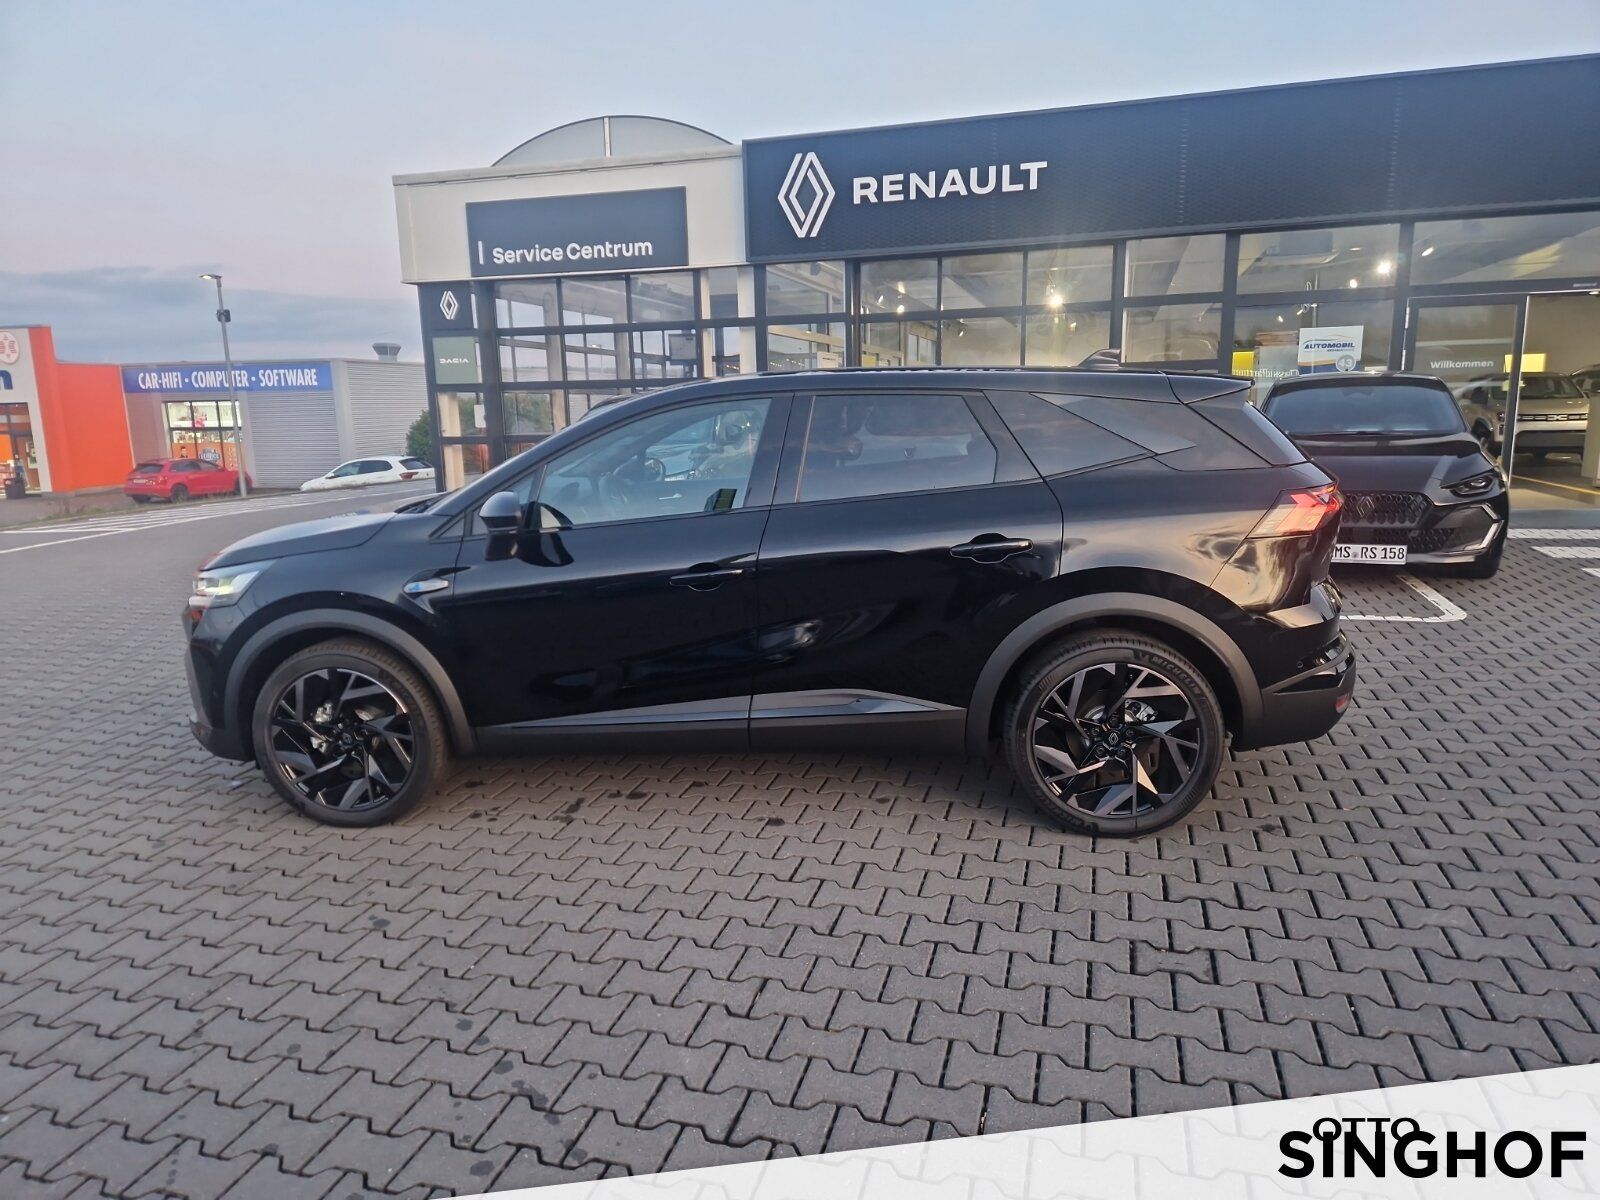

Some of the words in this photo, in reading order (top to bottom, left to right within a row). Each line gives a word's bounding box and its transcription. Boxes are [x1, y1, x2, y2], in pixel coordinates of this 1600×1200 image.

[852, 161, 1048, 205] RENAULT
[492, 244, 564, 264] Service
[566, 241, 653, 262] Centrum
[1304, 342, 1356, 350] AUTOMOBIL
[1430, 359, 1495, 370] Willkommen
[191, 370, 249, 388] COMPUTER
[259, 368, 318, 387] SOFTWARE
[1333, 546, 1351, 559] MS
[1360, 546, 1378, 560] RS
[1380, 547, 1406, 560] 158
